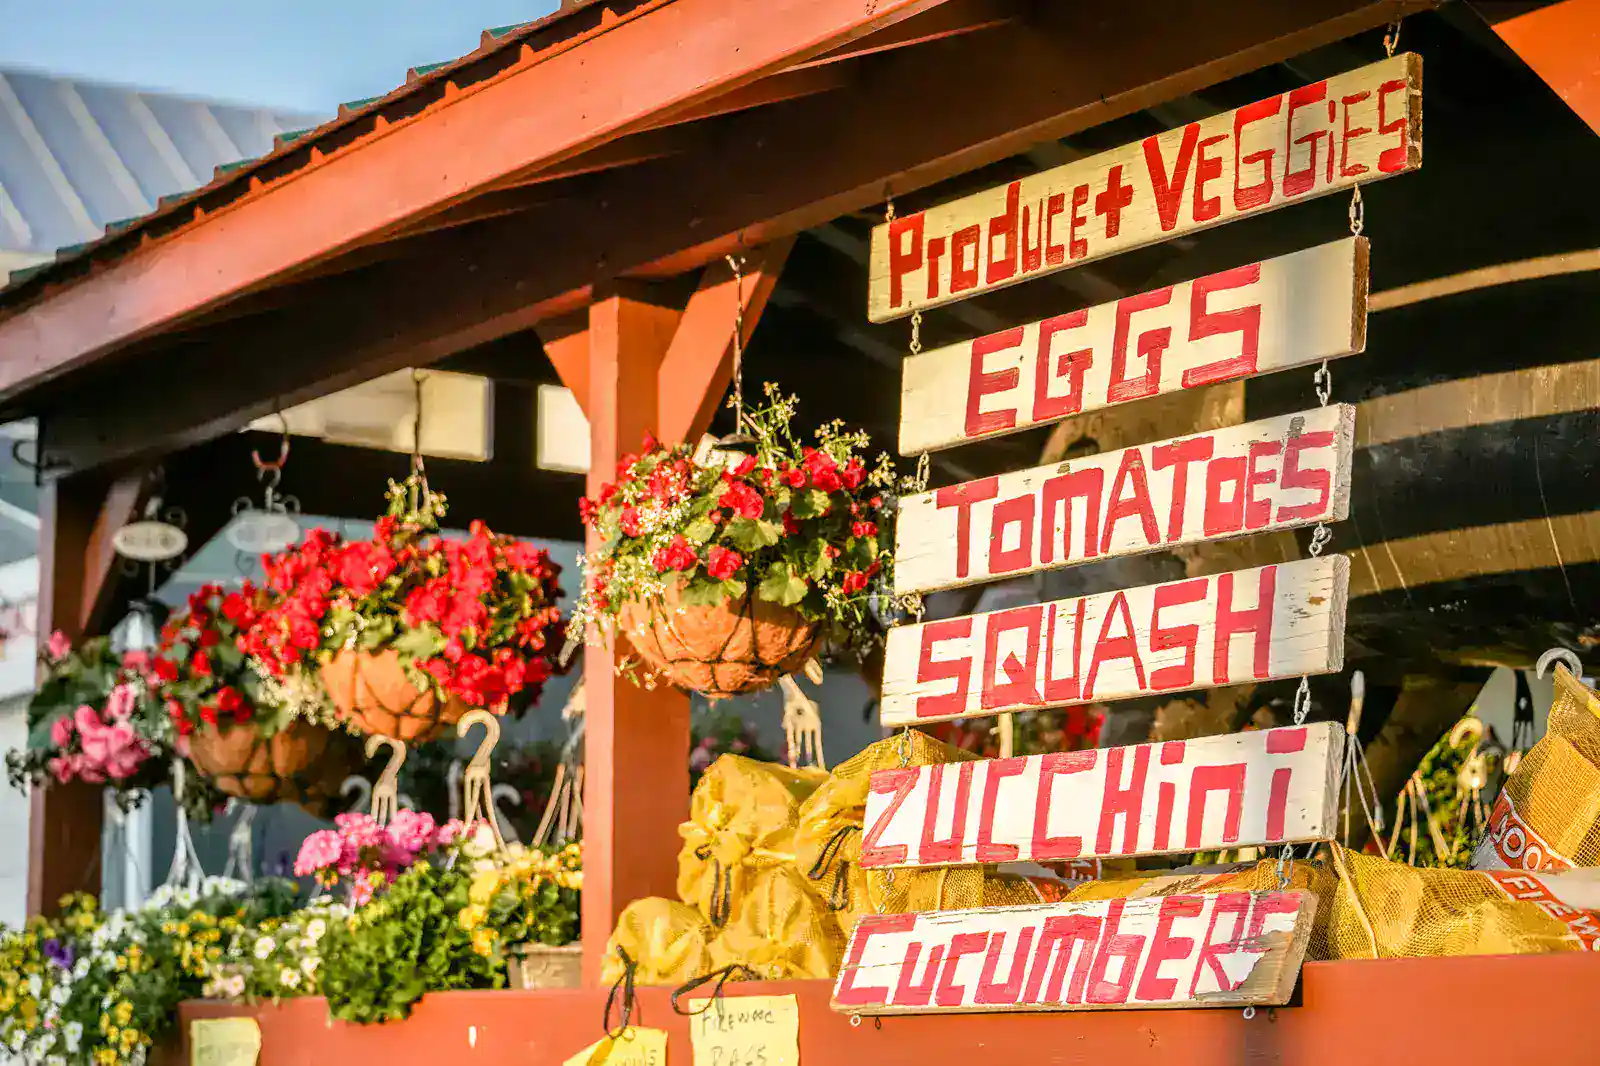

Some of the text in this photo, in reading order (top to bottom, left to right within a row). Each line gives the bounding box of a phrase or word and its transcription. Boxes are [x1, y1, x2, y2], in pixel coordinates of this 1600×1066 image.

[965, 262, 1261, 437] EGGS
[936, 431, 1335, 578] TOMATOES
[916, 566, 1278, 718] SQUASH
